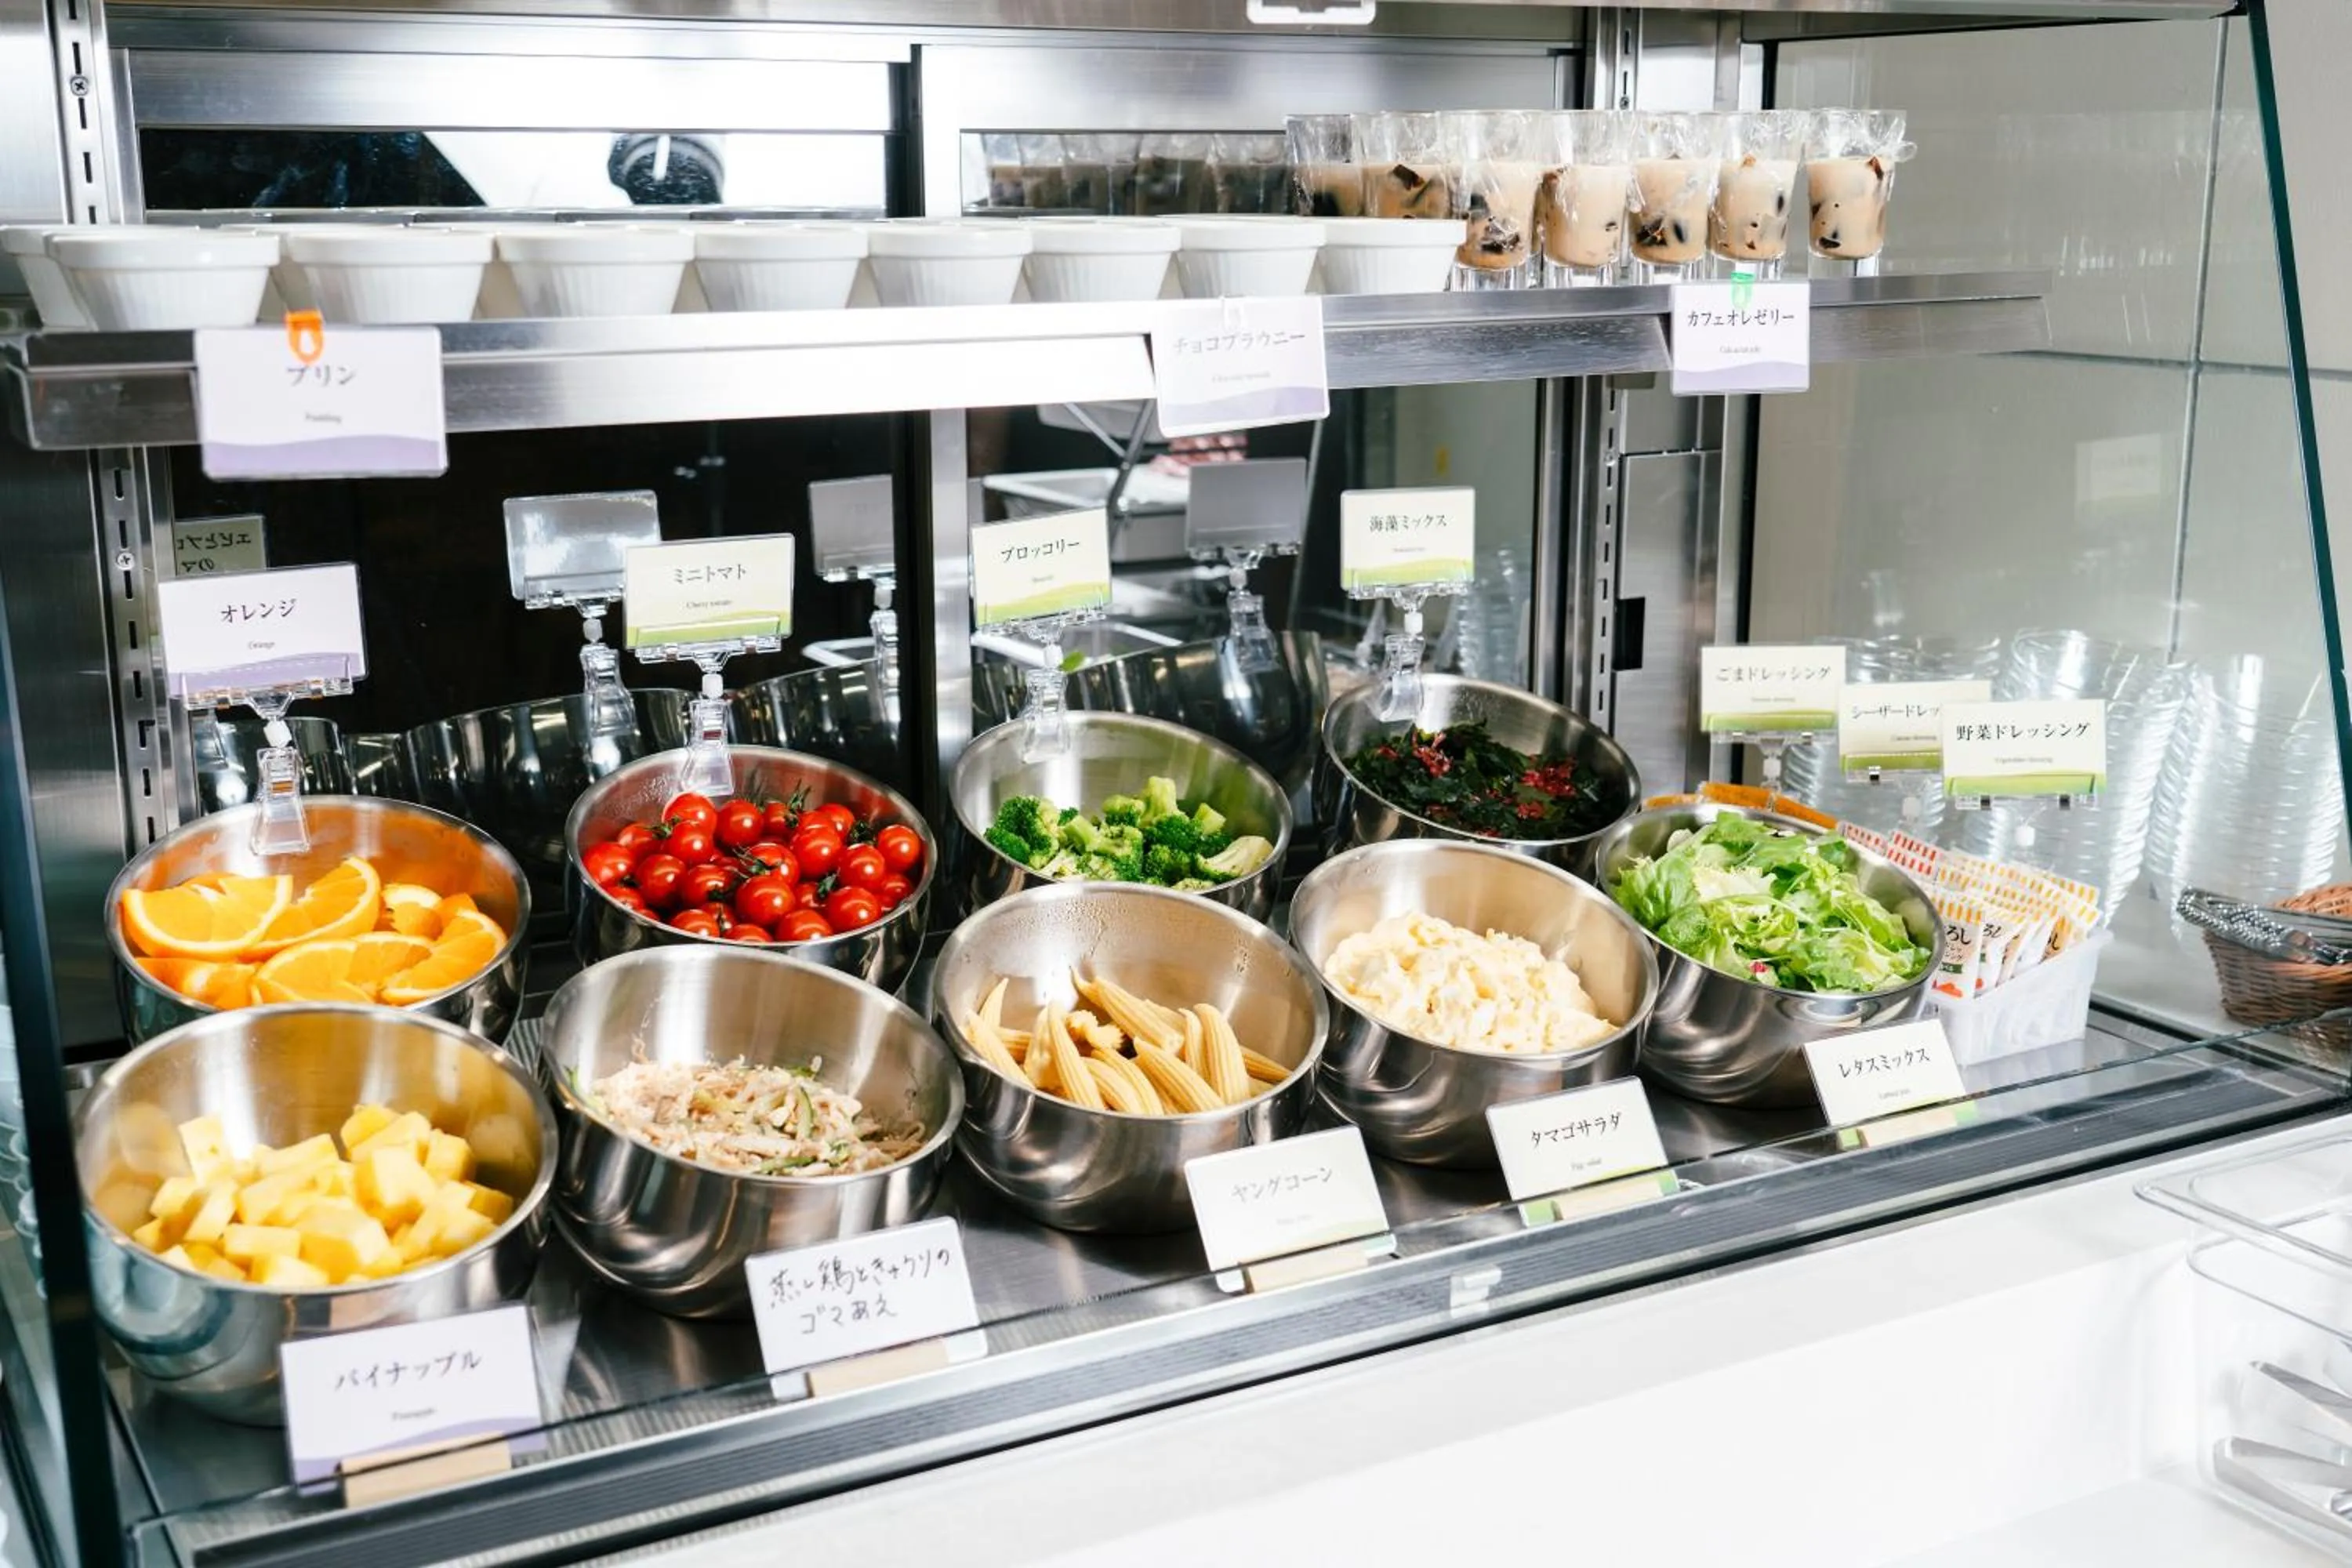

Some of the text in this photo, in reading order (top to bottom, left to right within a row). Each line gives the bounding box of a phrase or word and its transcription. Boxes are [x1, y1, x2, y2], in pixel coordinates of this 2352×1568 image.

[1688, 309, 1794, 326] カフェオレゼリー
[1175, 331, 1306, 354] チョコブラウニー
[286, 364, 357, 386] プリン
[1370, 514, 1446, 532] 海藻ミックス
[1001, 539, 1079, 561] ブロッコリー
[674, 564, 746, 584] ミニトマト
[220, 598, 296, 623] オレンジ
[1717, 666, 1831, 681] ごまドレッシング
[1957, 723, 2089, 741] 野菜ドレッシング
[1838, 1048, 1929, 1078] レタスミックス
[1531, 1112, 1621, 1148] タマゴサラダ
[1232, 1167, 1334, 1203] ヤングコーン
[334, 1350, 482, 1390] パイナップル
